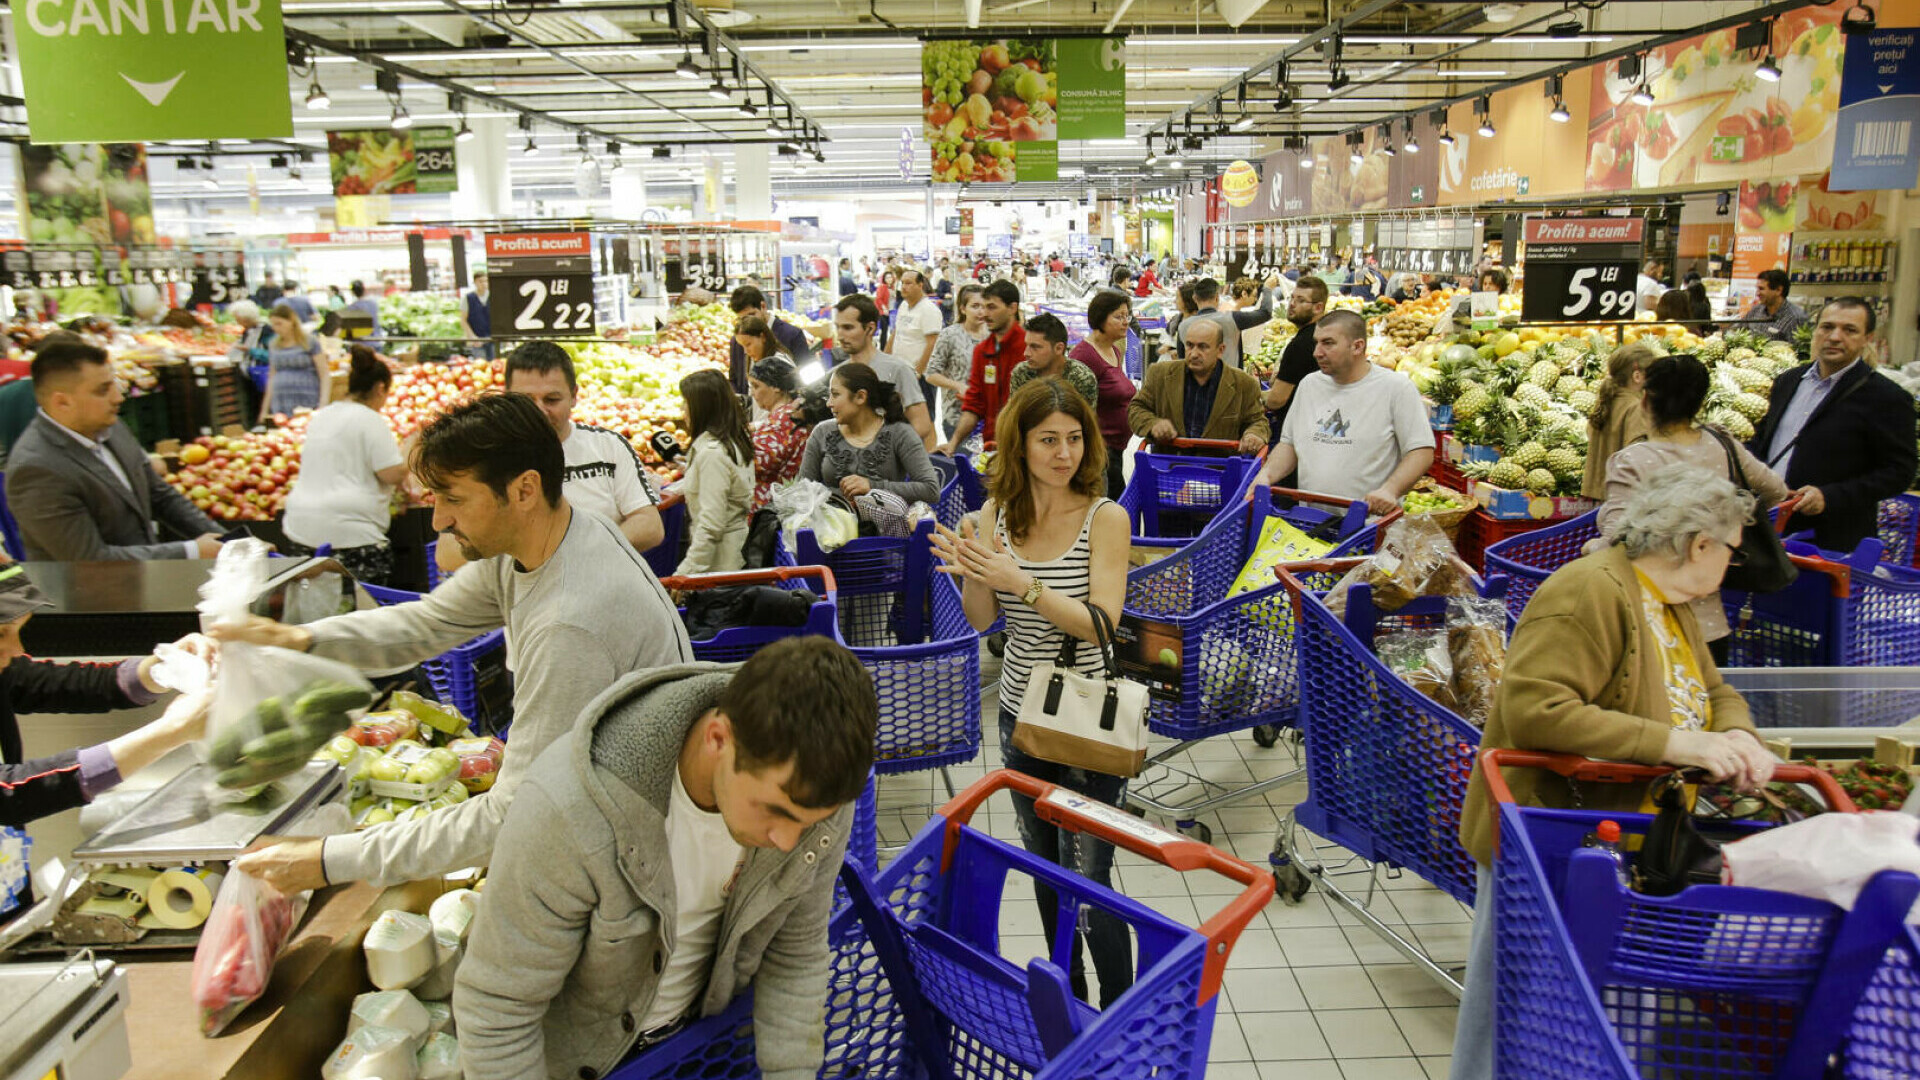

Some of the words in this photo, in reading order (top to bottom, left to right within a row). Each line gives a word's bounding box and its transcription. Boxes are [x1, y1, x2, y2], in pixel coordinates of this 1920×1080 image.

[1878, 63, 1897, 74] aici
[416, 152, 454, 170] 264
[1471, 167, 1517, 191] cofetărie
[1588, 222, 1631, 239] acum!
[493, 238, 539, 251] Profită
[541, 237, 583, 249] acum!
[704, 276, 725, 290] 99
[1562, 267, 1598, 317] 5
[1600, 267, 1619, 282] LEI
[515, 279, 548, 330] 2
[550, 279, 569, 295] LEI
[1599, 290, 1635, 315] 99
[553, 302, 593, 329] 22
